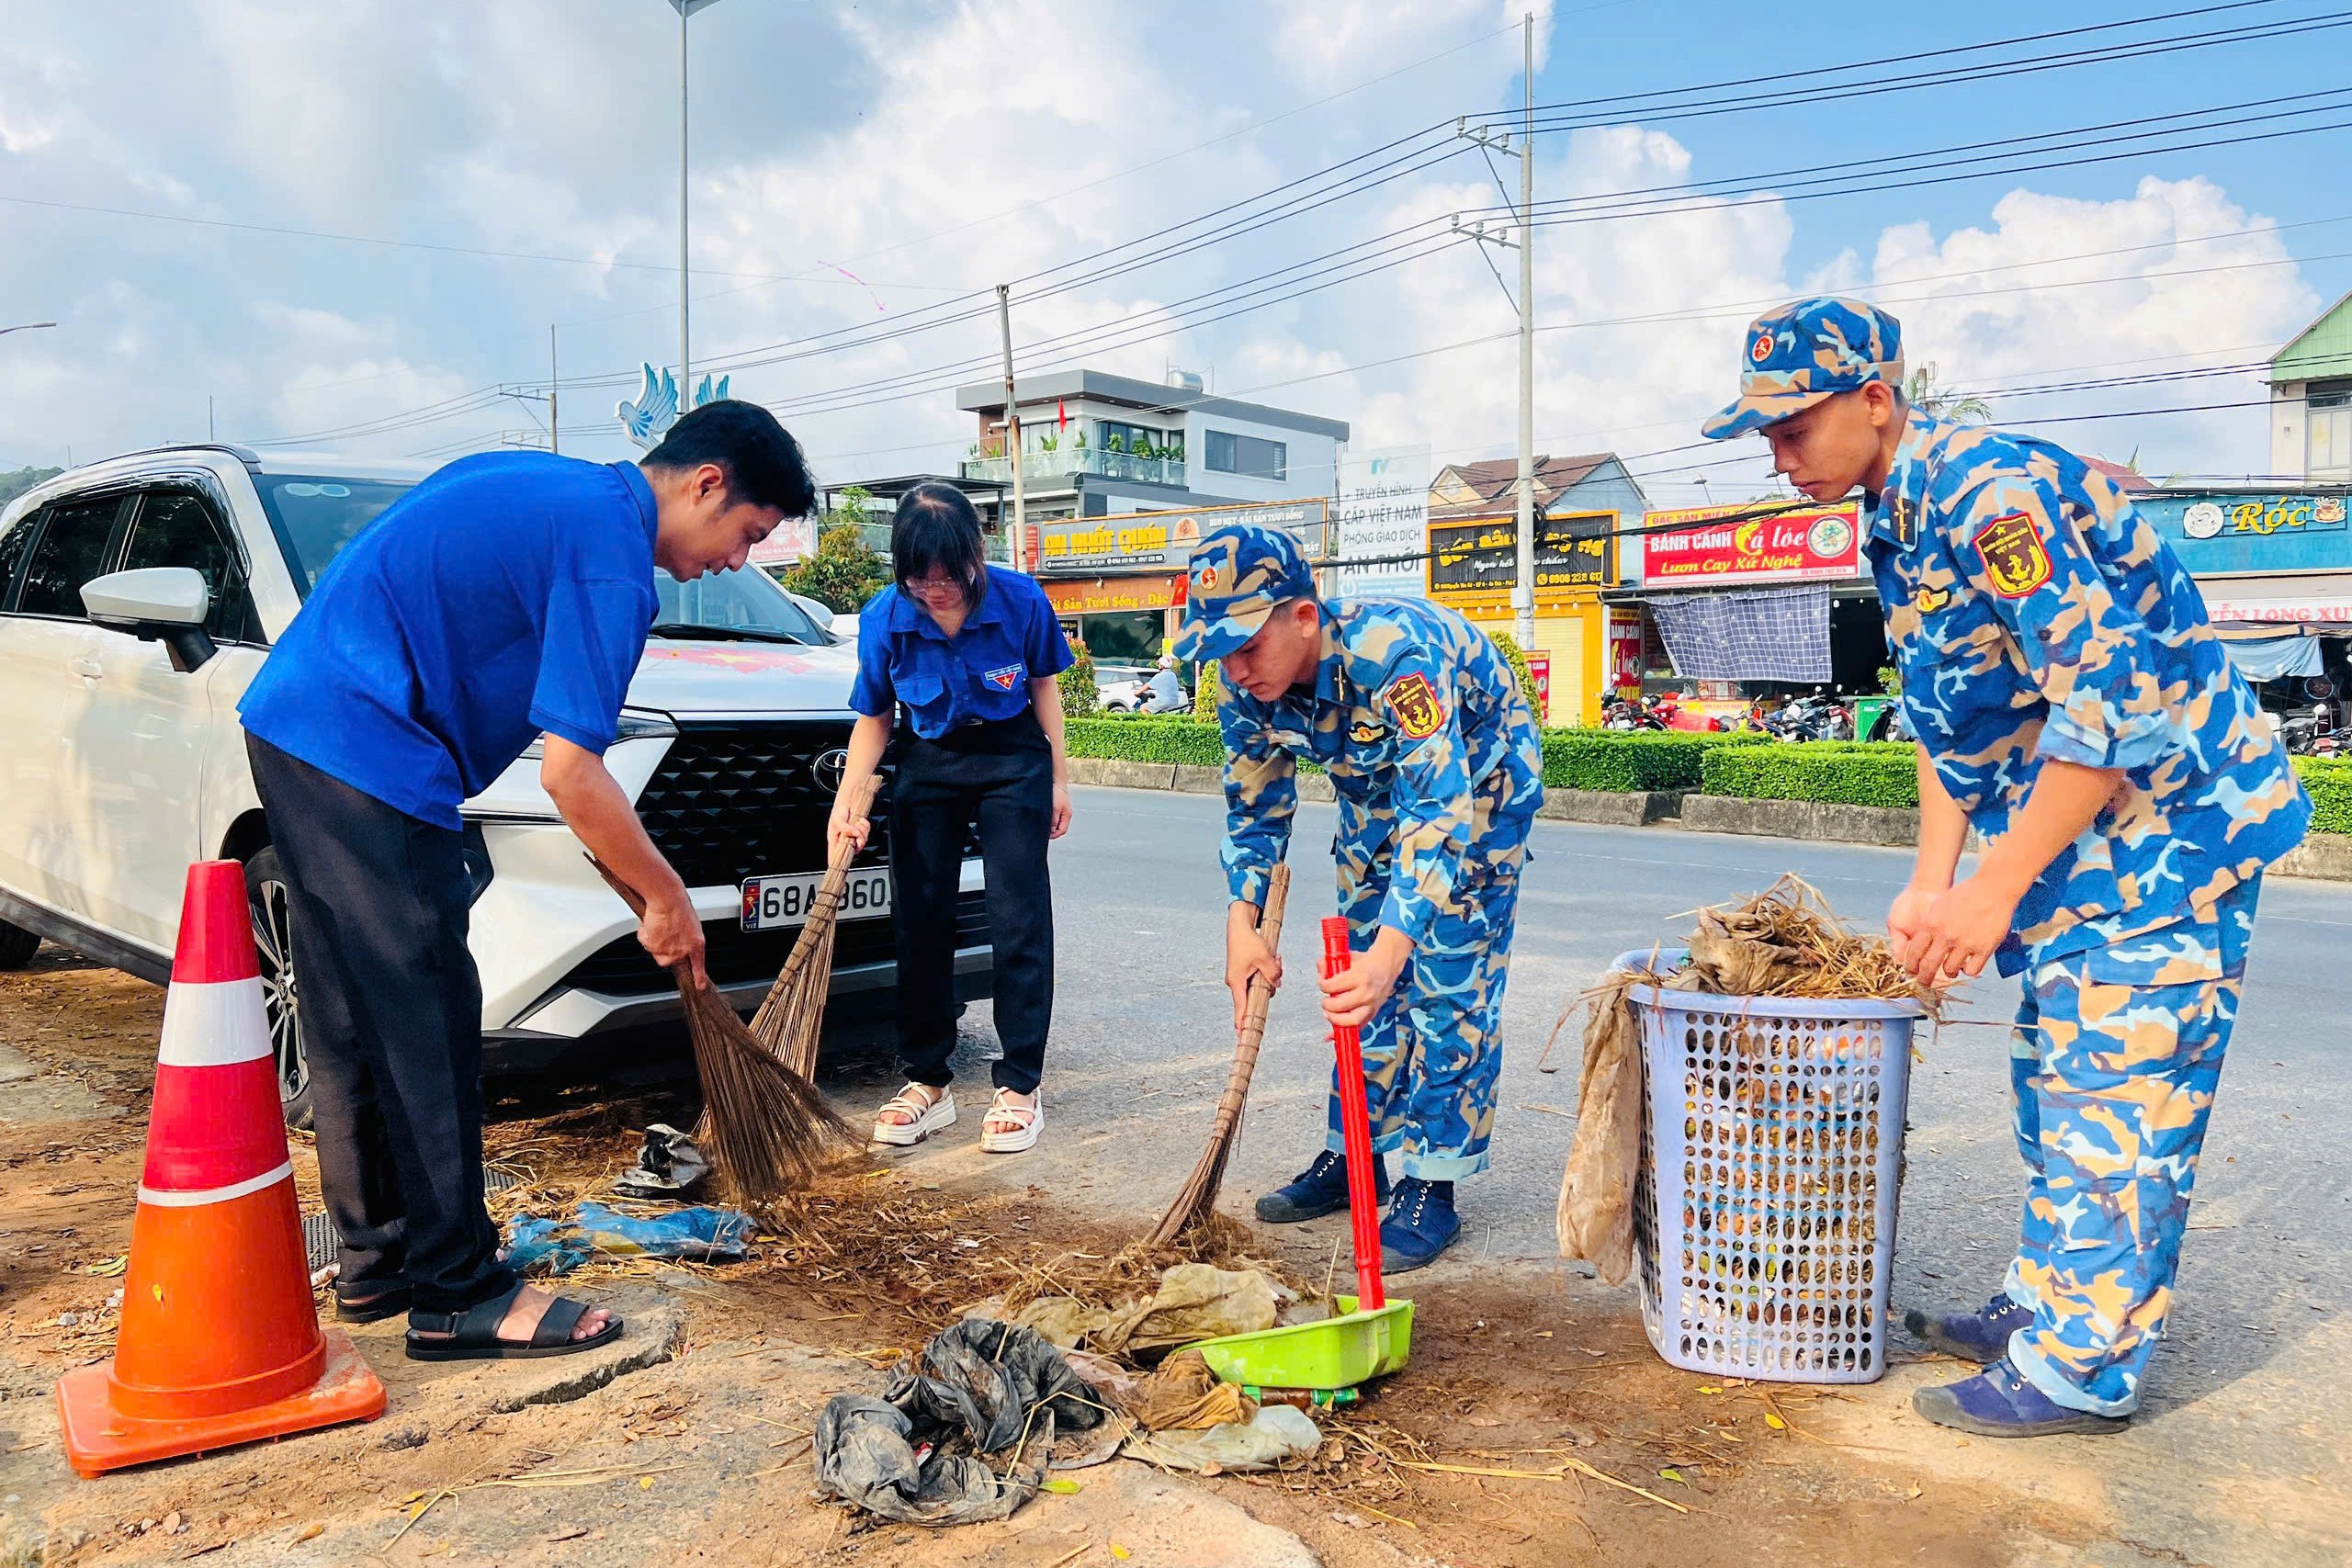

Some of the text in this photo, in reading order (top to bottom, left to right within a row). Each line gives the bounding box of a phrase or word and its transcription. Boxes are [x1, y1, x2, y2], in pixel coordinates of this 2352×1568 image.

[1369, 503, 1392, 526] VIỆT
[1395, 504, 1421, 522] NAM
[2231, 497, 2310, 535] Róc
[1044, 534, 1067, 556] AN
[1070, 524, 1114, 556] NHẤT
[1118, 522, 1167, 555] QUÁN
[1376, 530, 1397, 543] GIAO
[1650, 533, 1689, 553] BÁNH
[1692, 532, 1731, 550] CANH
[1702, 558, 1732, 574] Cay
[1762, 553, 1804, 570] Nghệ
[2252, 607, 2312, 621] LONG
[2317, 606, 2352, 621] XU
